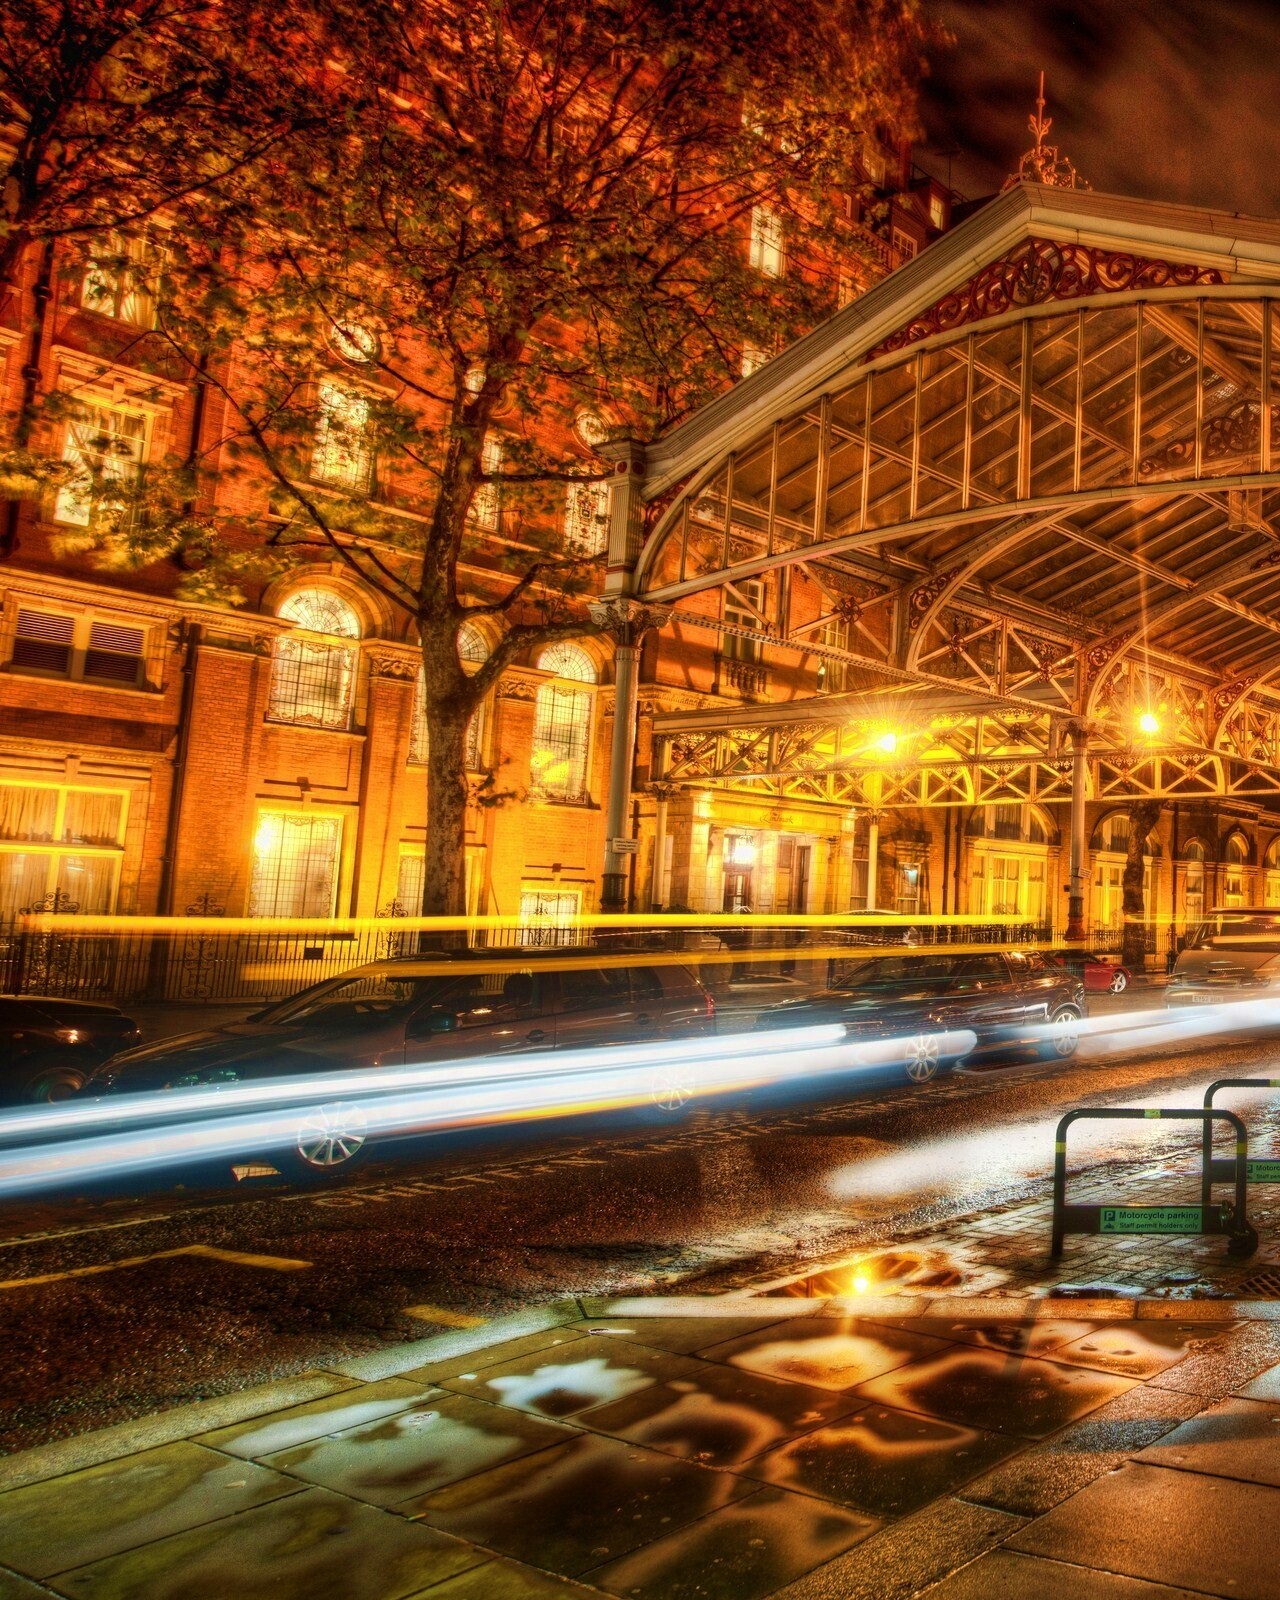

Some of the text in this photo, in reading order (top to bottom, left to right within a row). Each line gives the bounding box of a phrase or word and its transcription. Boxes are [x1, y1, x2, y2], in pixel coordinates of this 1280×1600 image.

[1120, 1211, 1199, 1220] Motorcycle parking
[1184, 1222, 1199, 1230] only
